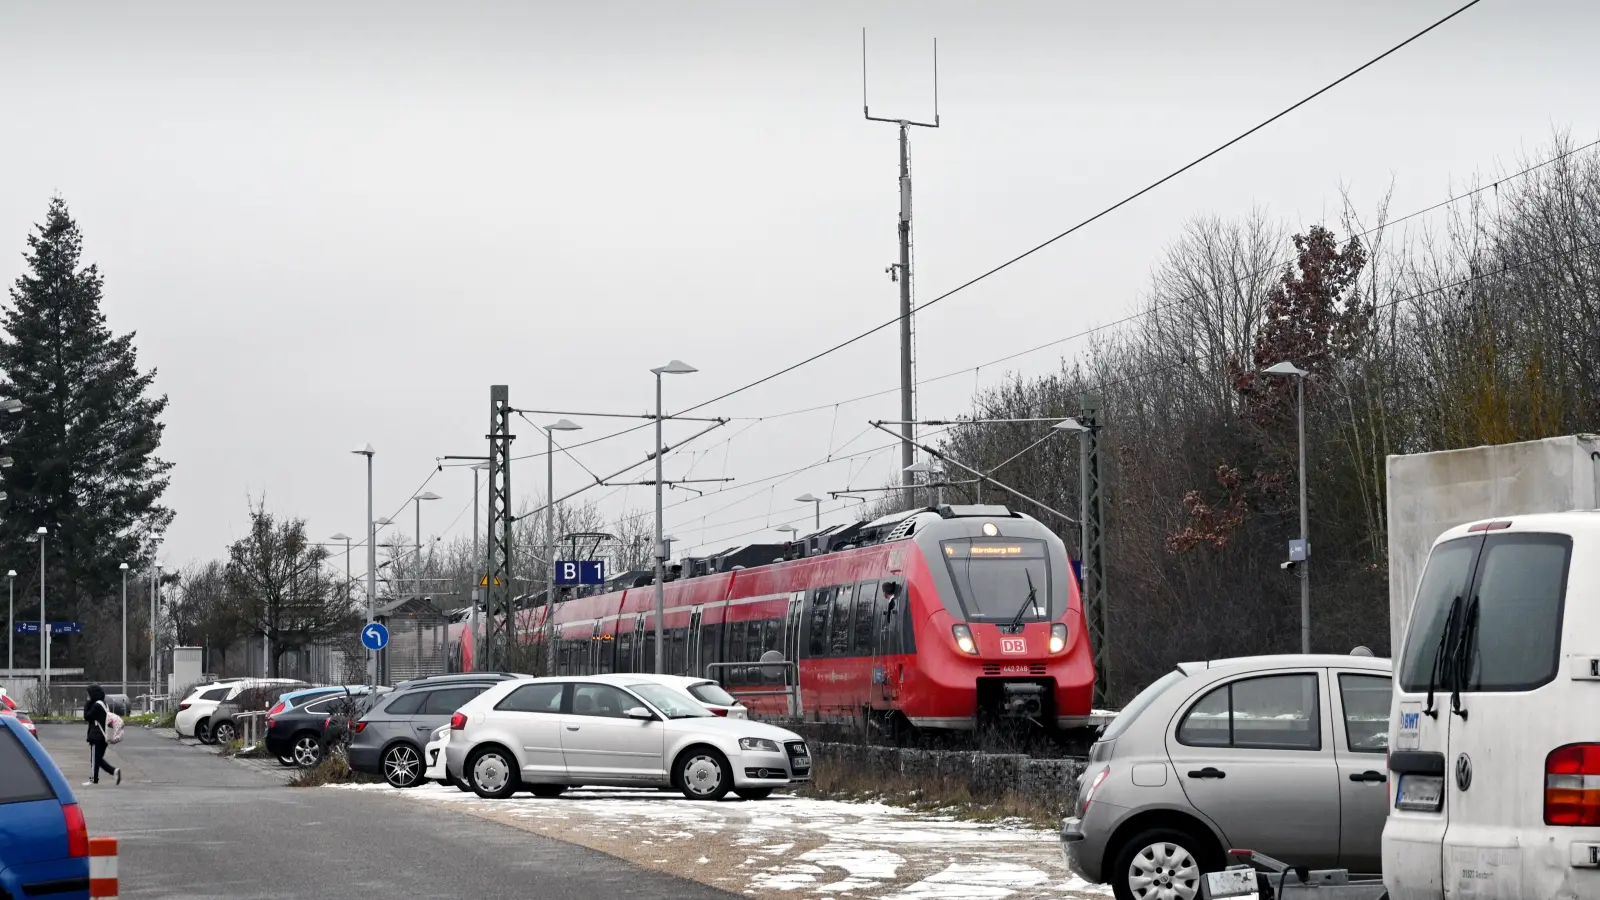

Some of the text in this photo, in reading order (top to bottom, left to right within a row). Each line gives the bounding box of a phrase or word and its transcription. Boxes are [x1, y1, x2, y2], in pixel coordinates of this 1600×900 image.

[564, 562, 576, 580] B
[594, 562, 602, 580] 1
[22, 622, 27, 630] 2
[1003, 640, 1024, 652] DB
[1404, 713, 1419, 729] BWT
